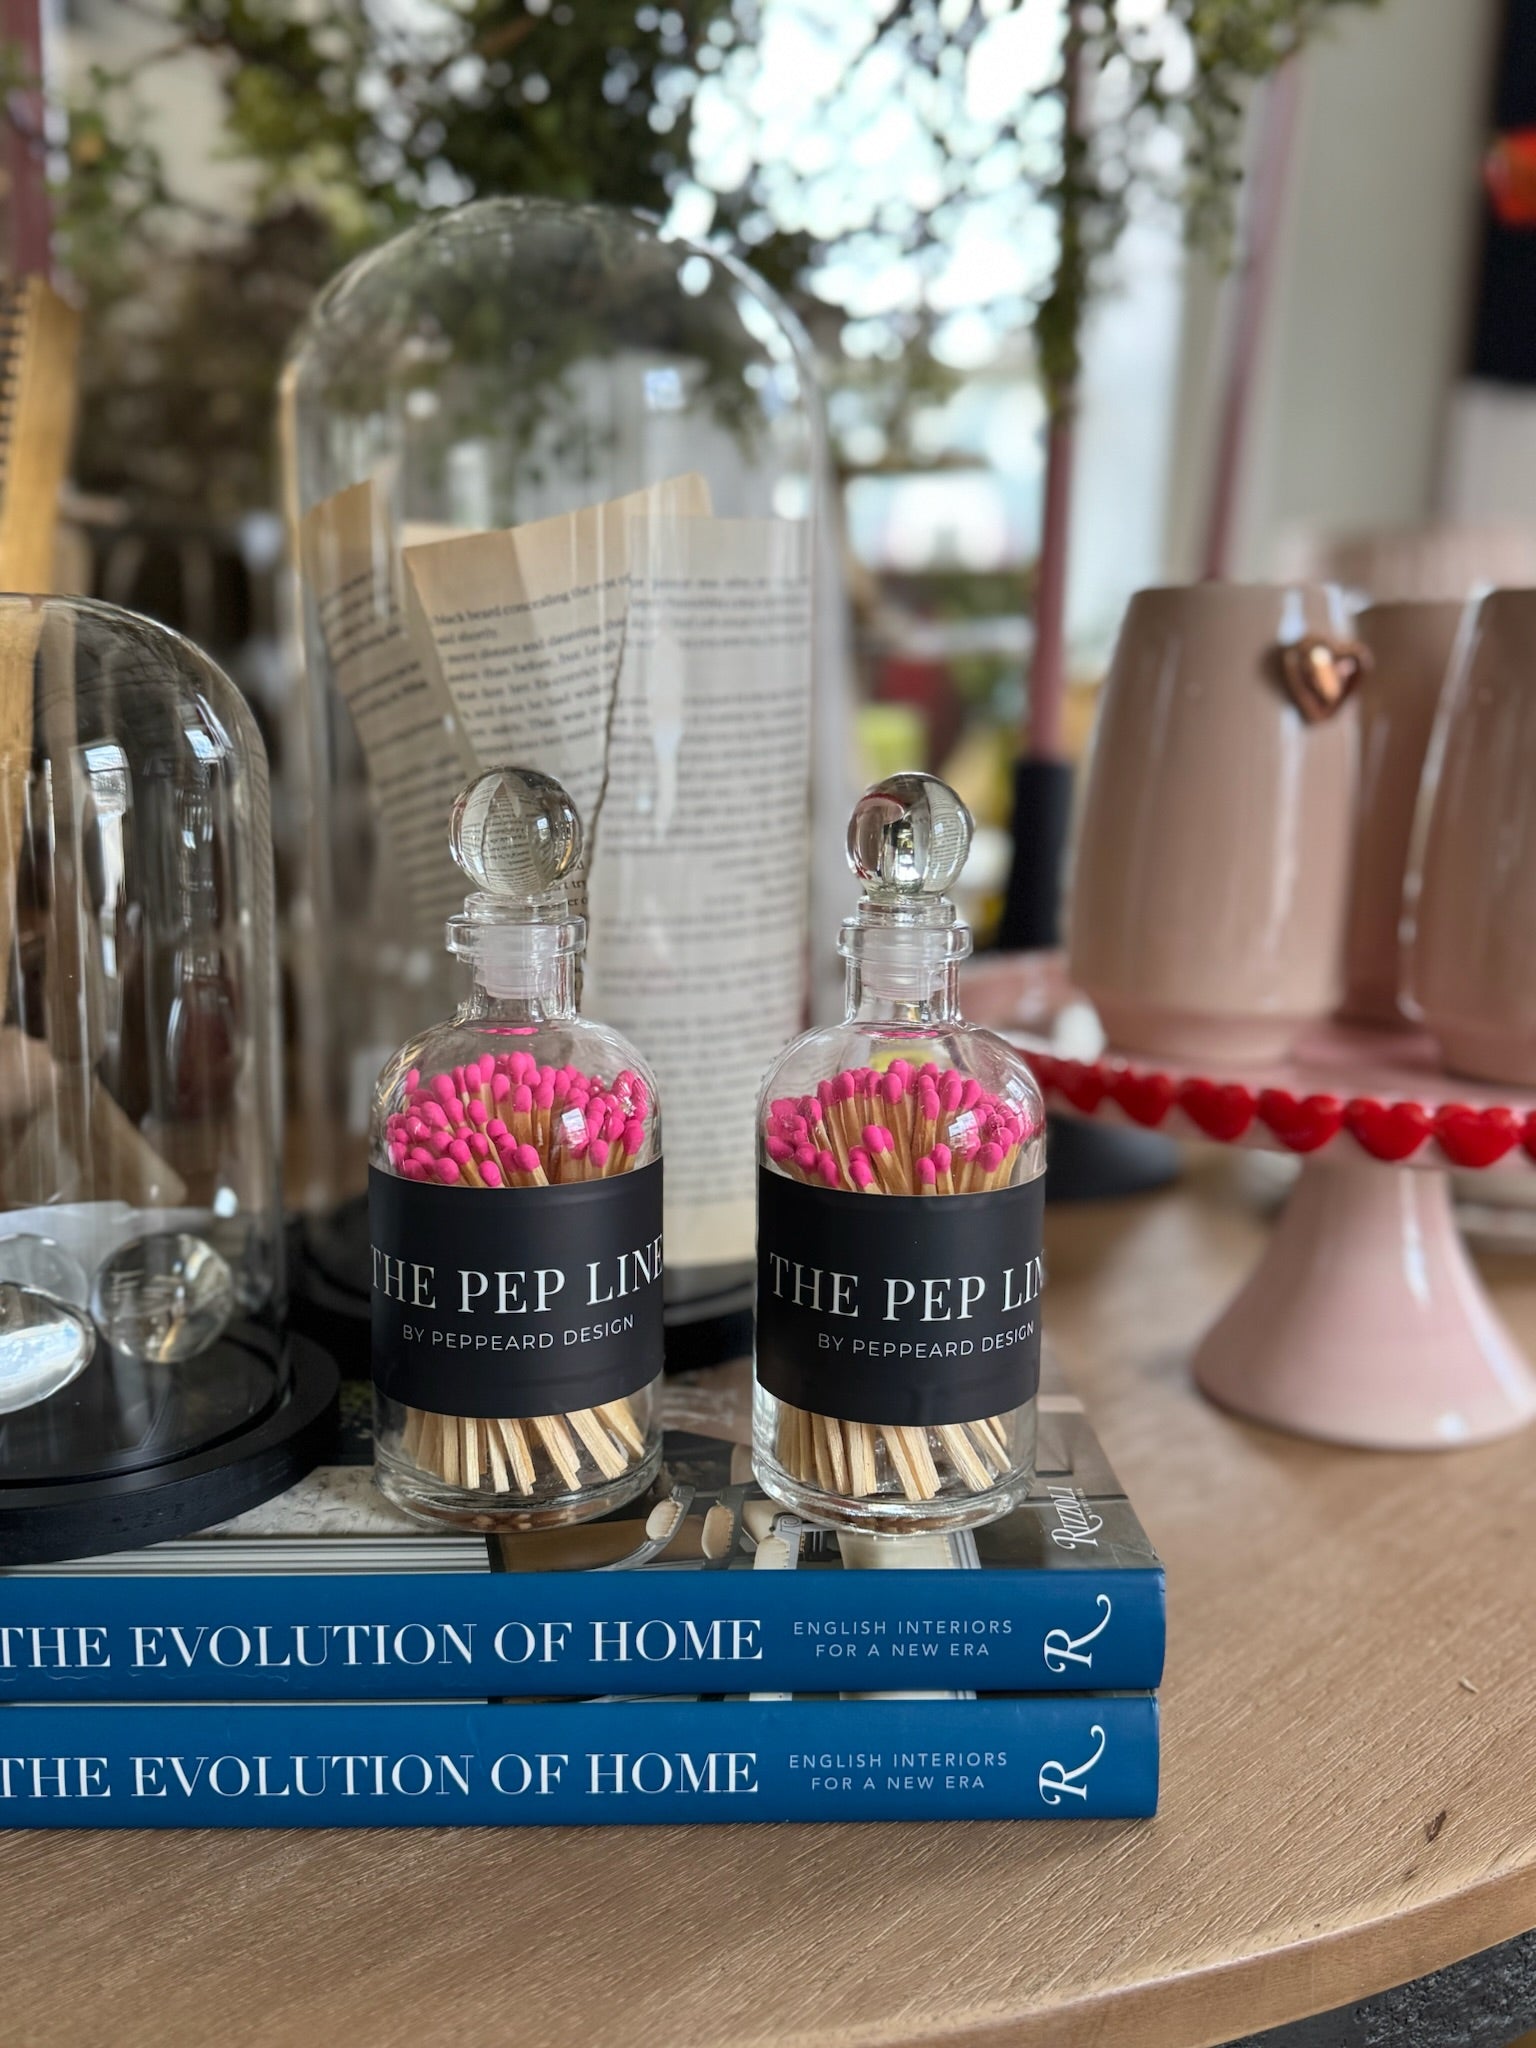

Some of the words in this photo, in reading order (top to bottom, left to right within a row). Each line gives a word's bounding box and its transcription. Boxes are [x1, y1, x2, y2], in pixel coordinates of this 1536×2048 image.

[370, 1244, 436, 1309] THE
[457, 1268, 566, 1314] PEP
[586, 1233, 663, 1306] LINE
[769, 1251, 859, 1318] THE
[882, 1275, 986, 1322] PEP
[403, 1324, 425, 1343] BY
[432, 1330, 554, 1351] PEPPEARD
[564, 1314, 635, 1346] DESIGN
[818, 1332, 844, 1351] BY
[852, 1339, 974, 1359] PEPPEARD
[981, 1320, 1034, 1353] DESIGN
[0, 1626, 110, 1668] THE
[130, 1624, 477, 1668] EVOLUTION
[494, 1621, 572, 1664] OF
[589, 1620, 763, 1662] HOME
[794, 1621, 886, 1635] ENGLISH
[898, 1620, 1012, 1635] INTERIORS
[1043, 1593, 1112, 1673] R
[816, 1644, 856, 1657] FOR
[867, 1644, 880, 1657] A
[892, 1643, 939, 1656] NEW
[950, 1643, 989, 1656] ERA
[0, 1757, 111, 1798] THE
[129, 1754, 474, 1797] EVOLUTION
[491, 1753, 569, 1795] OF
[585, 1752, 759, 1795] HOME
[789, 1753, 881, 1769] ENGLISH
[893, 1752, 1008, 1767] INTERIORS
[1038, 1724, 1106, 1805] R
[811, 1777, 852, 1790] FOR
[863, 1777, 876, 1790] A
[887, 1776, 935, 1789] NEW
[945, 1775, 985, 1789] ERA
